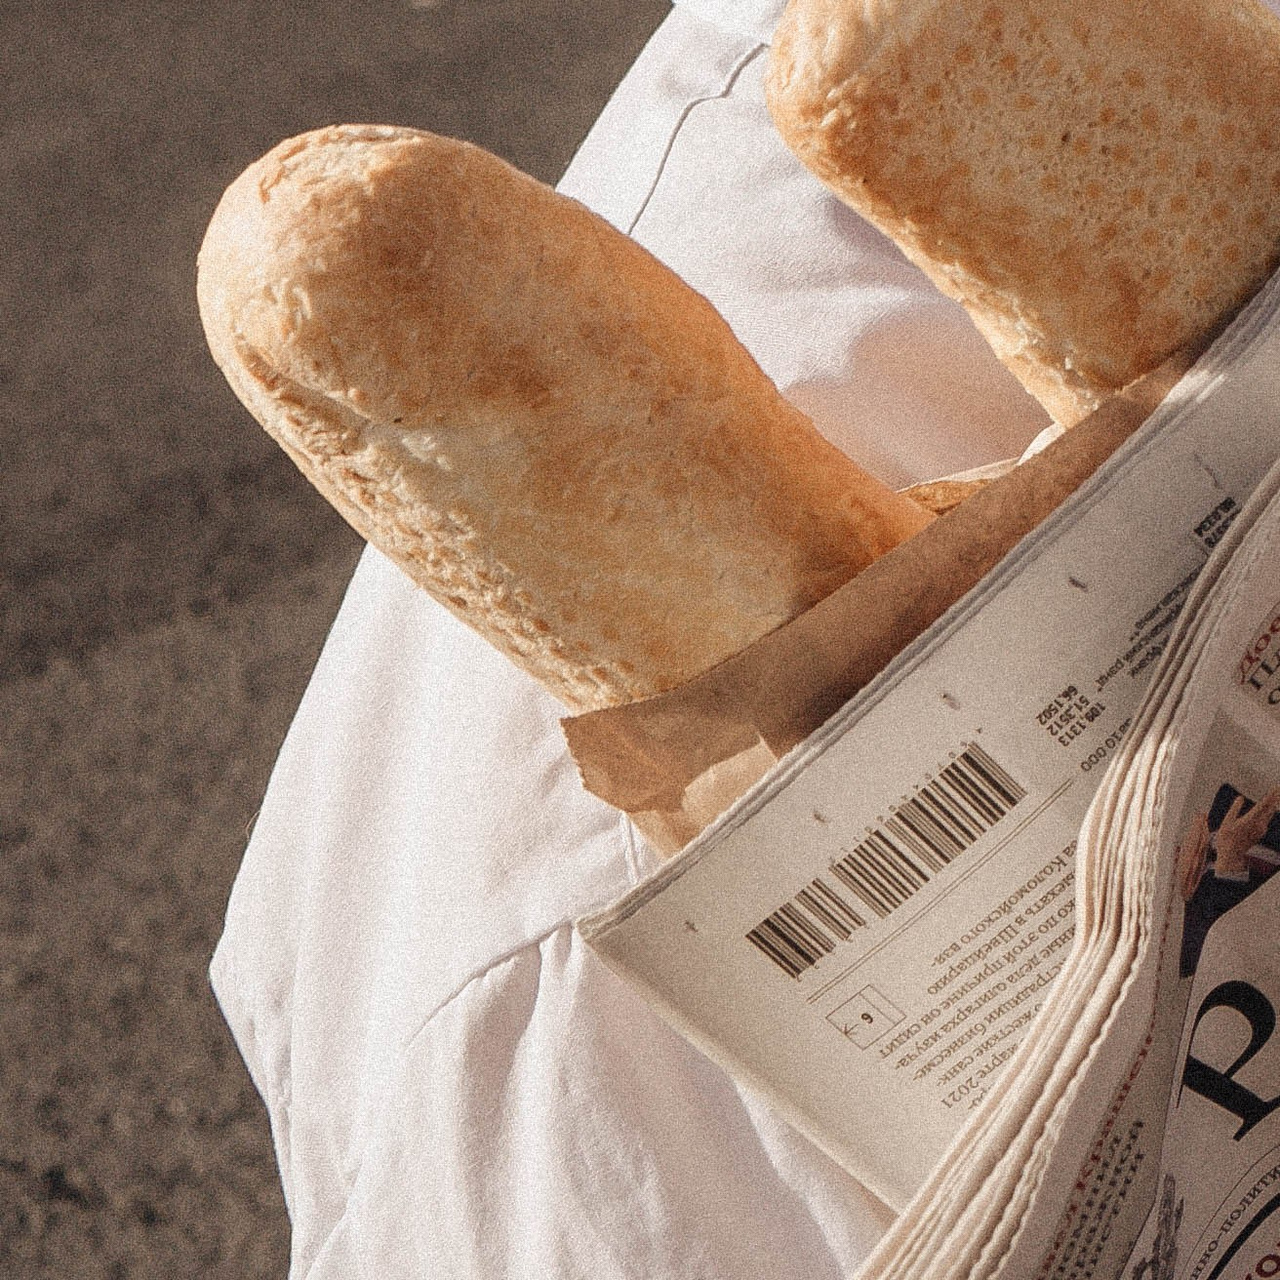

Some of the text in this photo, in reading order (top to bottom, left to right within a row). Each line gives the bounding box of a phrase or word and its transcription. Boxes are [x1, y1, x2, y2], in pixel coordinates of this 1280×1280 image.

[1046, 694, 1091, 736] 51,3512
[960, 854, 1066, 943] Коломойского
[926, 870, 1076, 995] ыехать в Швейцарию
[1037, 914, 1059, 934] по
[931, 941, 961, 967] взя-
[1002, 931, 1039, 963] этой
[941, 961, 998, 1009] причине
[1006, 953, 1040, 984] дела
[860, 1012, 874, 1024] 6
[920, 1008, 942, 1026] он
[940, 981, 1008, 1034] олигарха
[878, 1023, 922, 1059] сидит
[894, 1031, 943, 1070] изуча-
[912, 1022, 988, 1081] бизнесме-
[939, 1010, 1033, 1085] жесткие санк-
[940, 1076, 980, 1109] 2021
